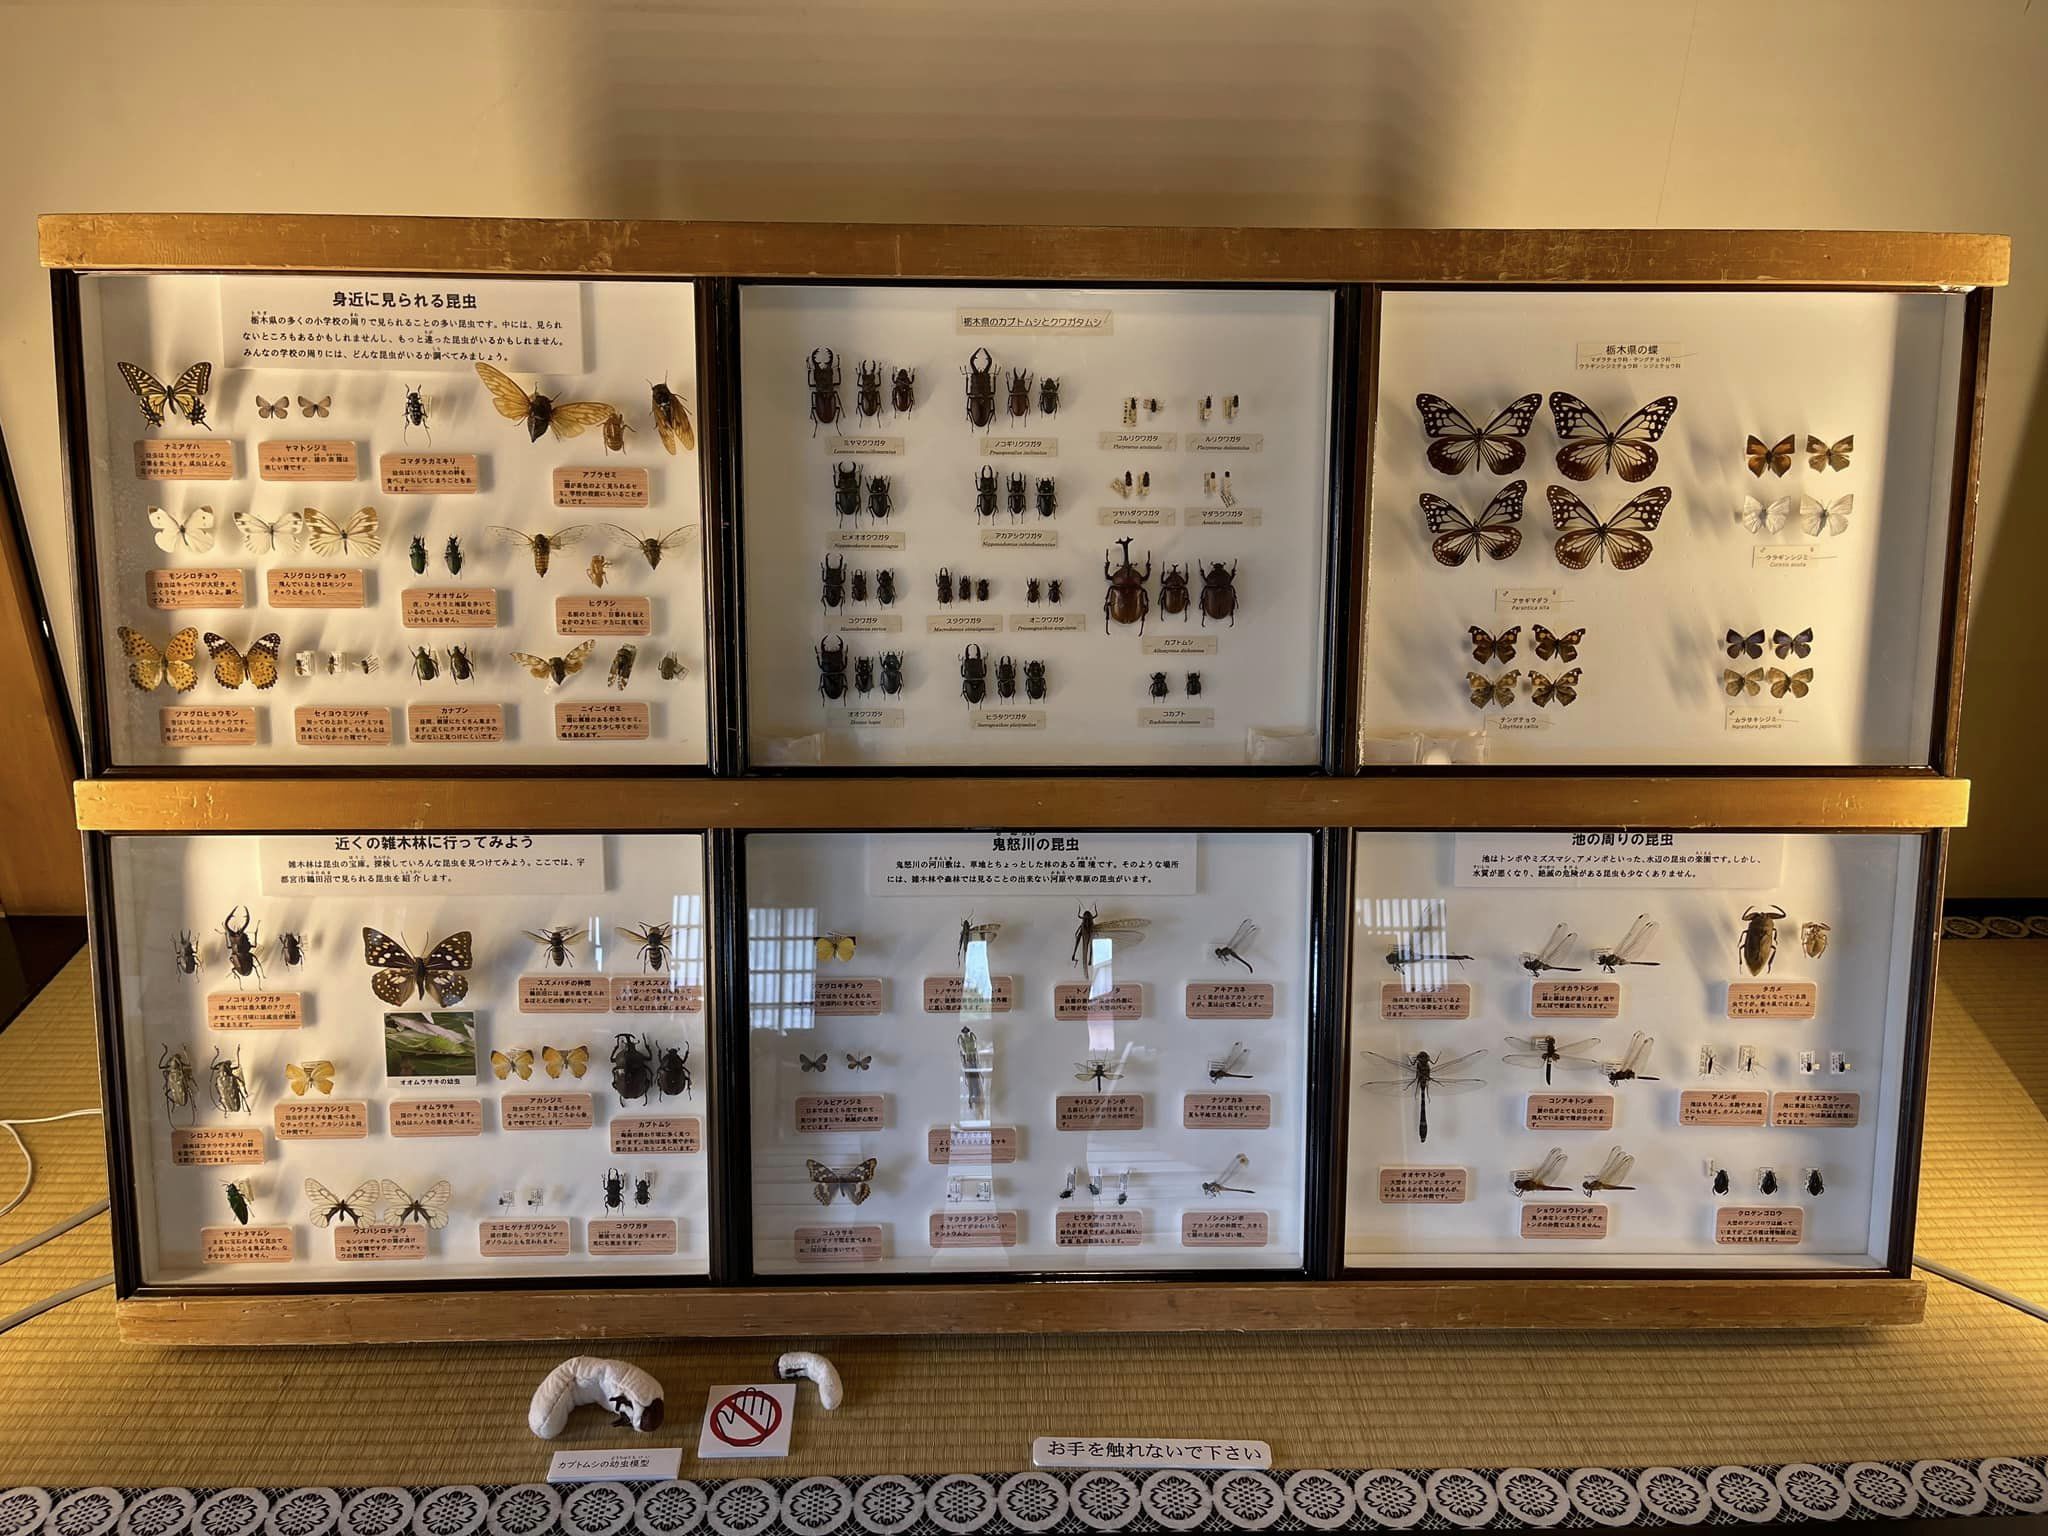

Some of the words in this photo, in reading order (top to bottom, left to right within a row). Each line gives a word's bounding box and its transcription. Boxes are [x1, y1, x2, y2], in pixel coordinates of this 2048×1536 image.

[333, 291, 477, 309] 身近に見られる昆虫
[964, 317, 1102, 328] 栃木県のカブトムシとクワガタムシ
[1605, 345, 1658, 355] 栃木県の蝶
[335, 836, 534, 850] 近くの雑木林に行ってみよう
[992, 837, 1080, 852] 鬼怒川の昆虫
[1571, 833, 1673, 846] 池の周りの昆虫
[1048, 1440, 1261, 1460] お手を触れないで下さい
[558, 1459, 650, 1469] カブトムシの幼虫模型
